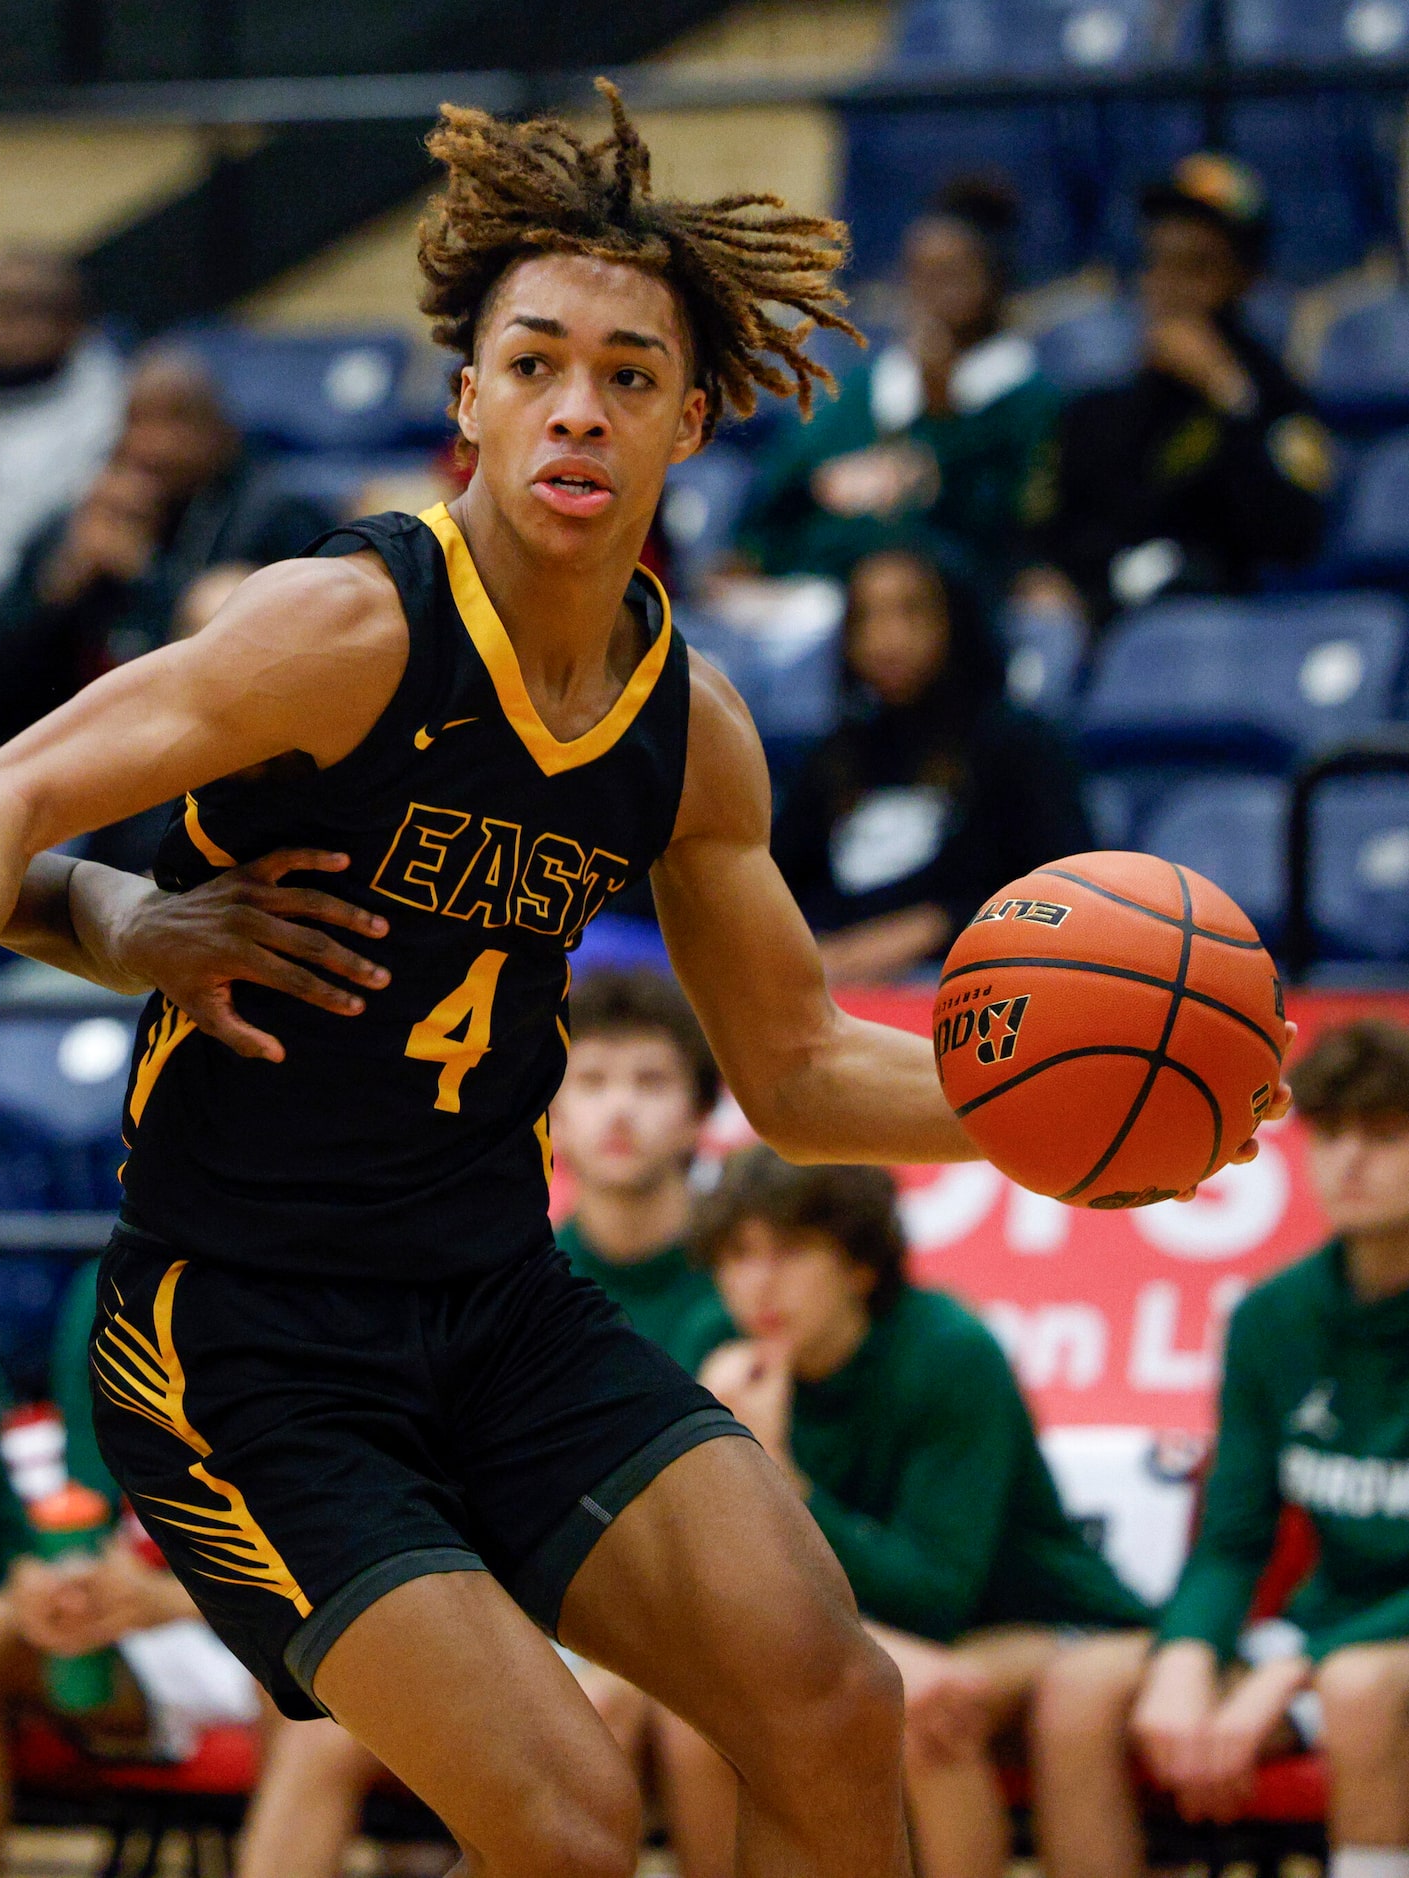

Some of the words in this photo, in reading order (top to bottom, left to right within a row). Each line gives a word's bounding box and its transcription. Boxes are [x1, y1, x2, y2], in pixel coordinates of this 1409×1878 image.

[370, 802, 629, 948] EAST
[968, 899, 1072, 928] ELIT
[404, 949, 509, 1113] 4
